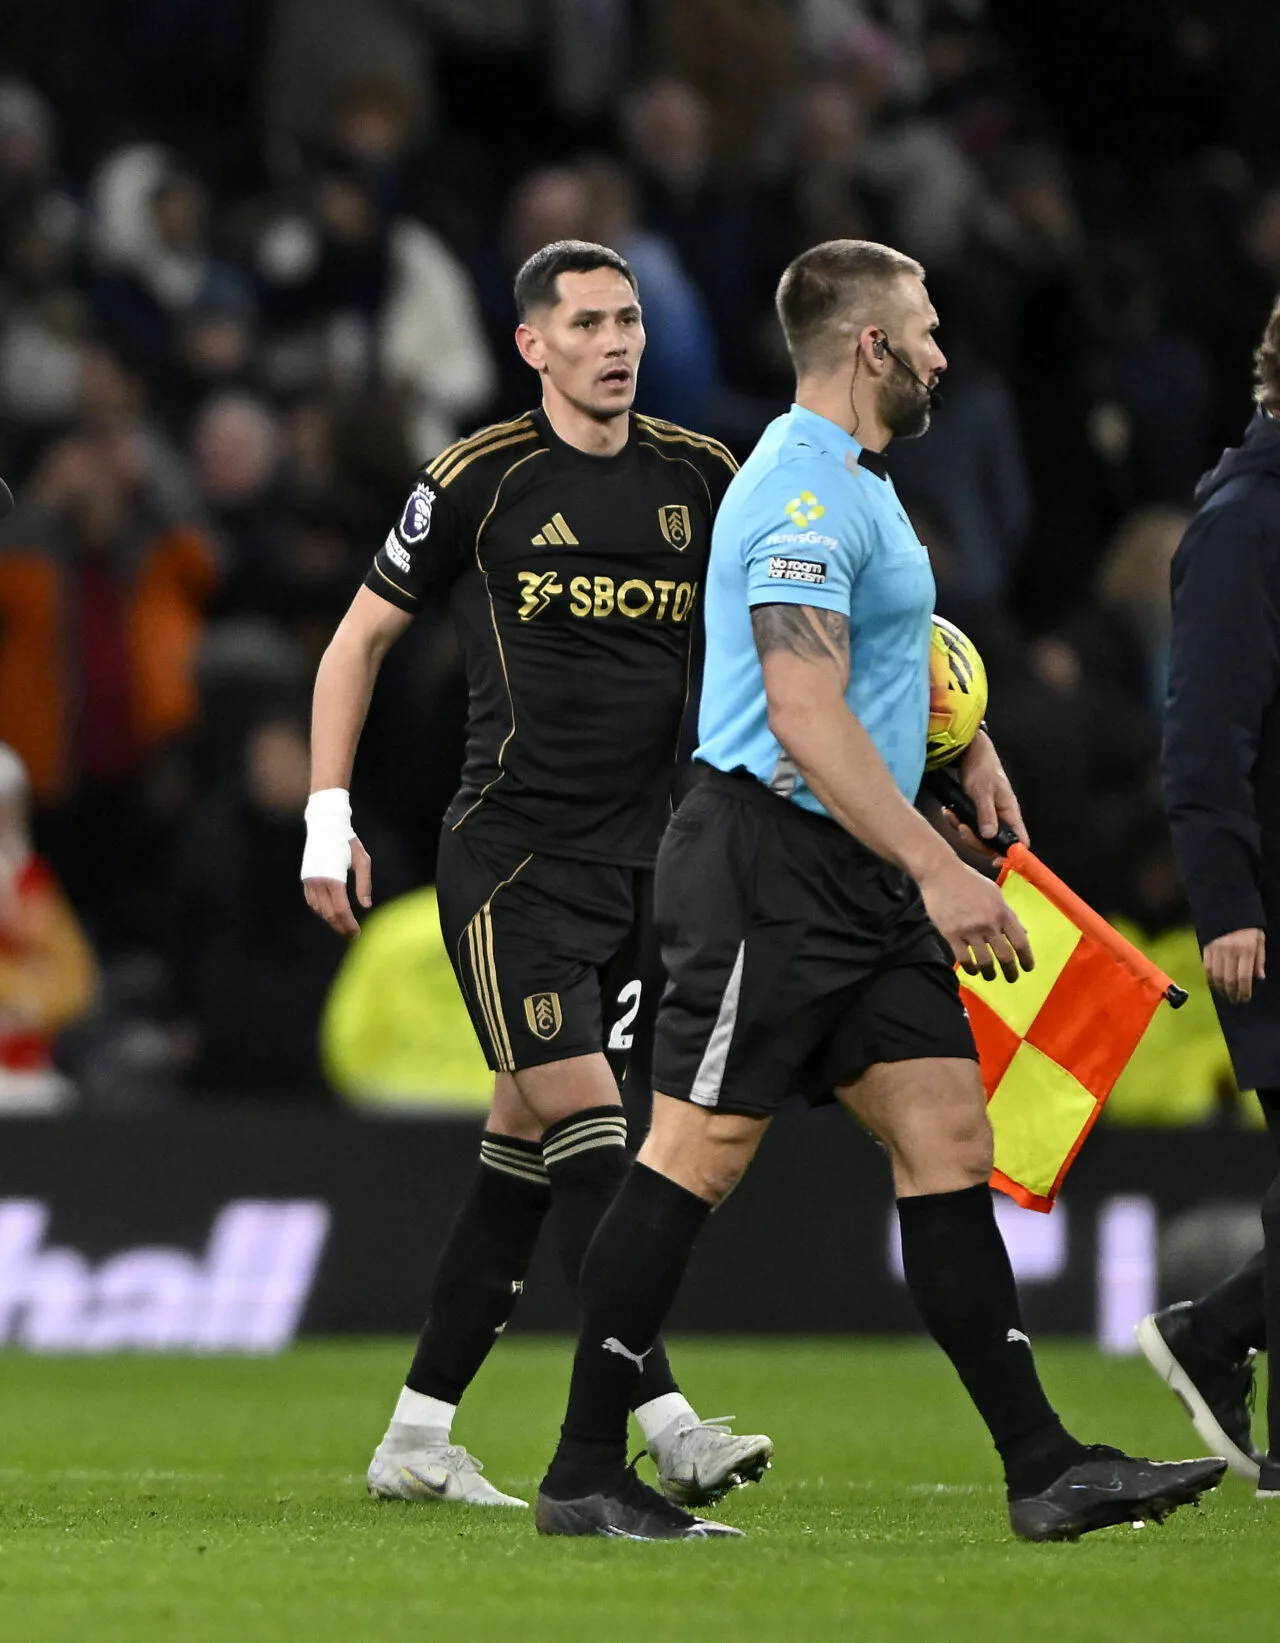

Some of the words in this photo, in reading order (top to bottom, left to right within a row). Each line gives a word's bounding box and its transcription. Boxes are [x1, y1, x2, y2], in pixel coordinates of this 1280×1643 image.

[769, 557, 787, 570] No
[788, 560, 822, 574] room
[570, 576, 698, 621] SBOTO
[608, 979, 642, 1049] 2
